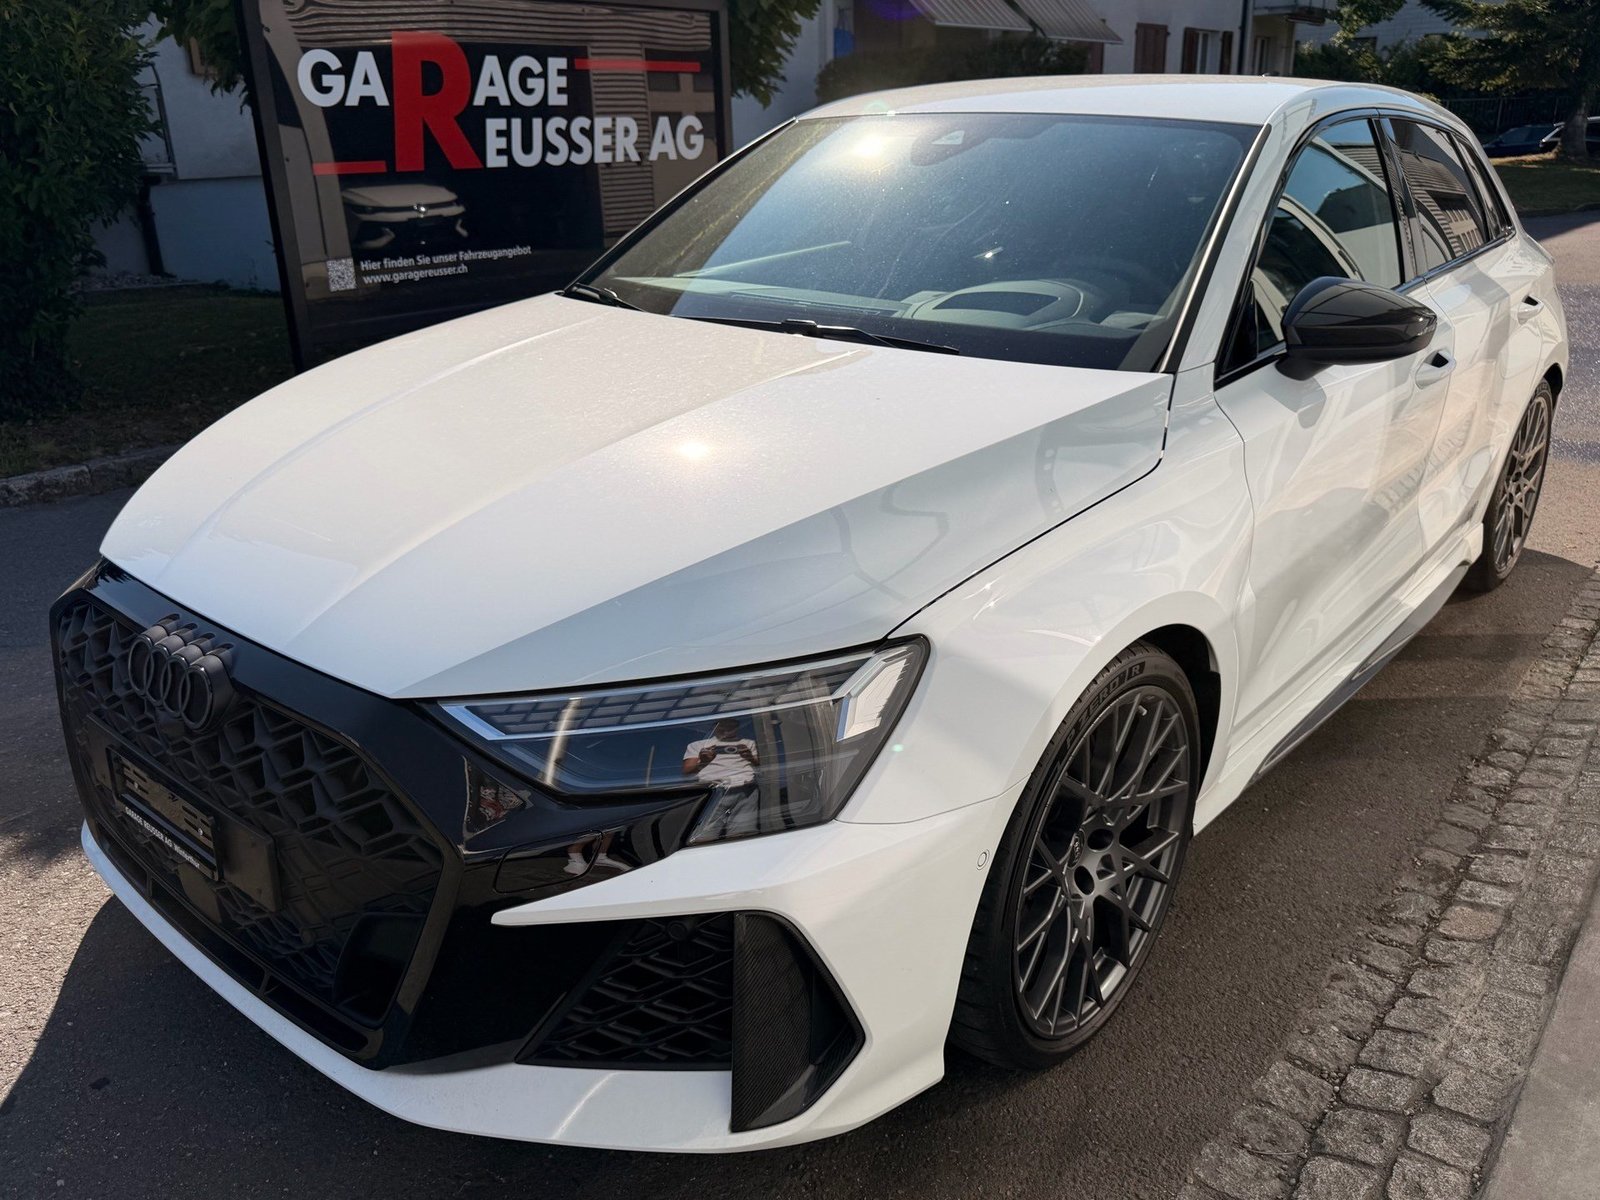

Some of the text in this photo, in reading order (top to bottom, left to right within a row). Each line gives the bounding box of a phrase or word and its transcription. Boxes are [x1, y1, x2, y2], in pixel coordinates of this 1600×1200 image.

[297, 30, 569, 173] GARAGE
[648, 115, 705, 161] AG
[360, 246, 532, 271] Hier finden Sie unser Fahrzeugangebot
[362, 264, 469, 285] www.garagereusser.ch
[1079, 681, 1119, 725] ZERO
[1131, 664, 1142, 679] R
